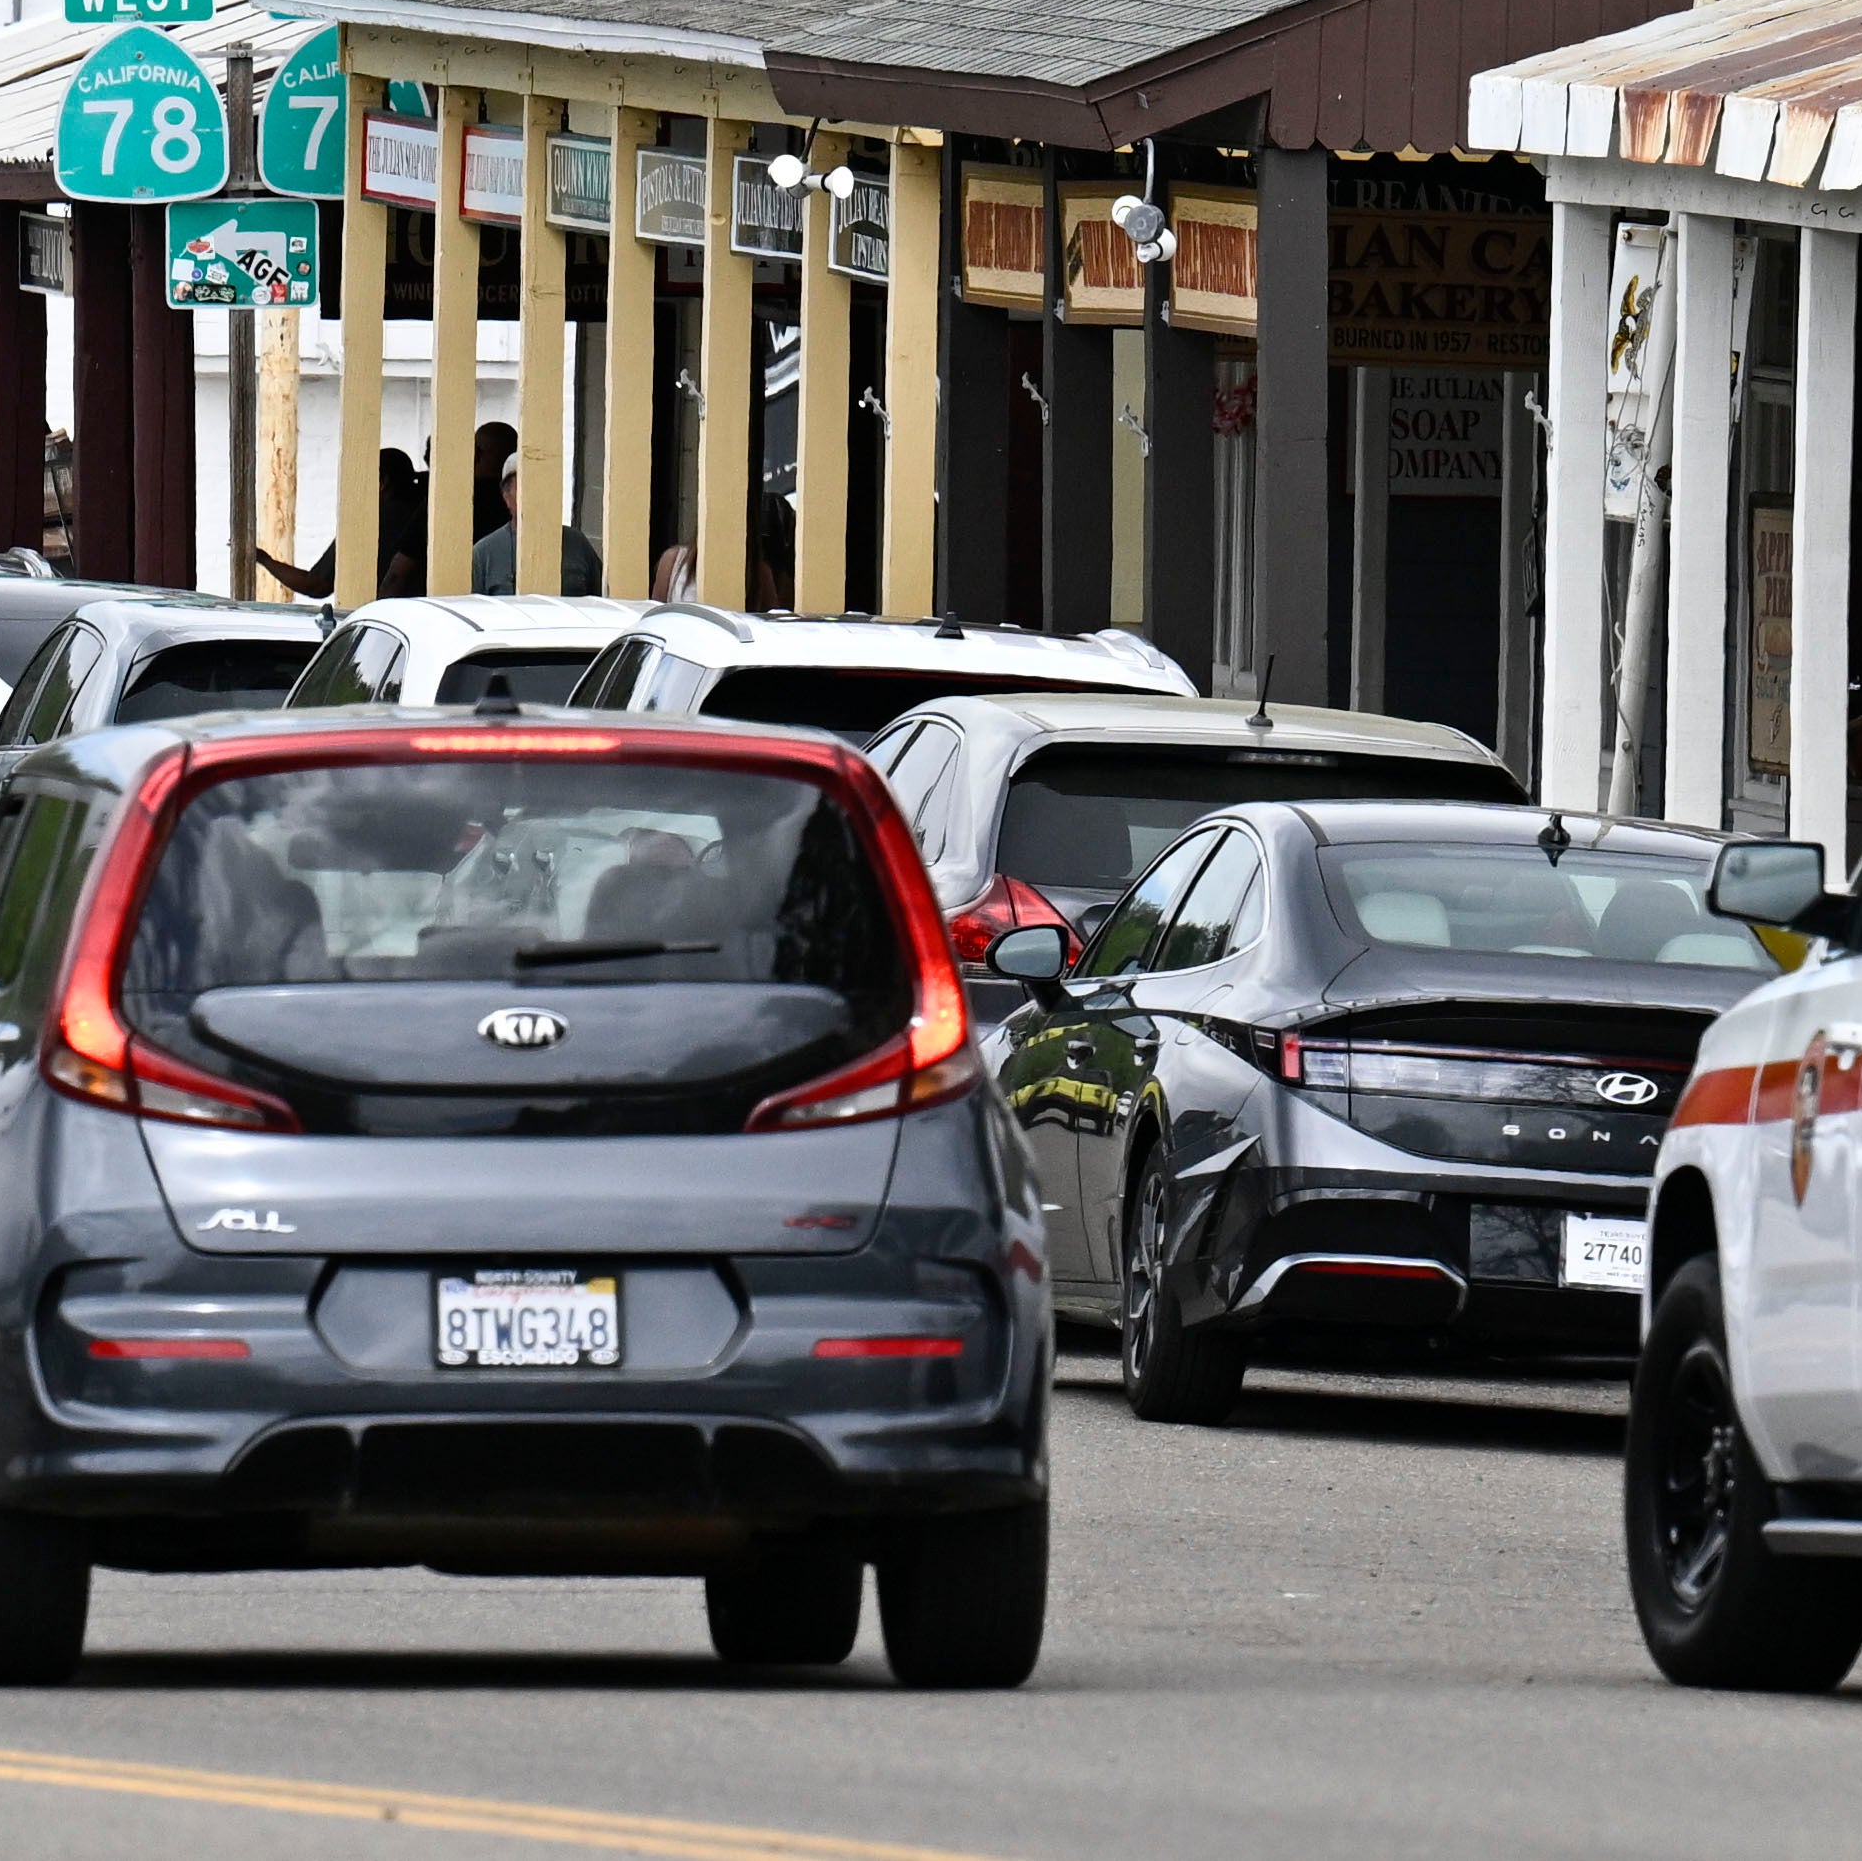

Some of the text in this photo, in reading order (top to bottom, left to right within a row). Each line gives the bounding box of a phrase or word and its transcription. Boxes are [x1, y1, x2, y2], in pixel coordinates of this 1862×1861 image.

[77, 62, 202, 94] CALIFORNIA
[82, 95, 202, 177] 78
[287, 95, 339, 171] 7
[1333, 327, 1405, 351] BURNED
[1410, 329, 1427, 352] IN
[1432, 331, 1472, 353] 1957
[1423, 377, 1504, 401] JULIAN
[1390, 408, 1481, 442] SOAP
[490, 1012, 560, 1046] KIA
[1583, 1240, 1643, 1266] 27740
[447, 1307, 609, 1350] 8TWG348
